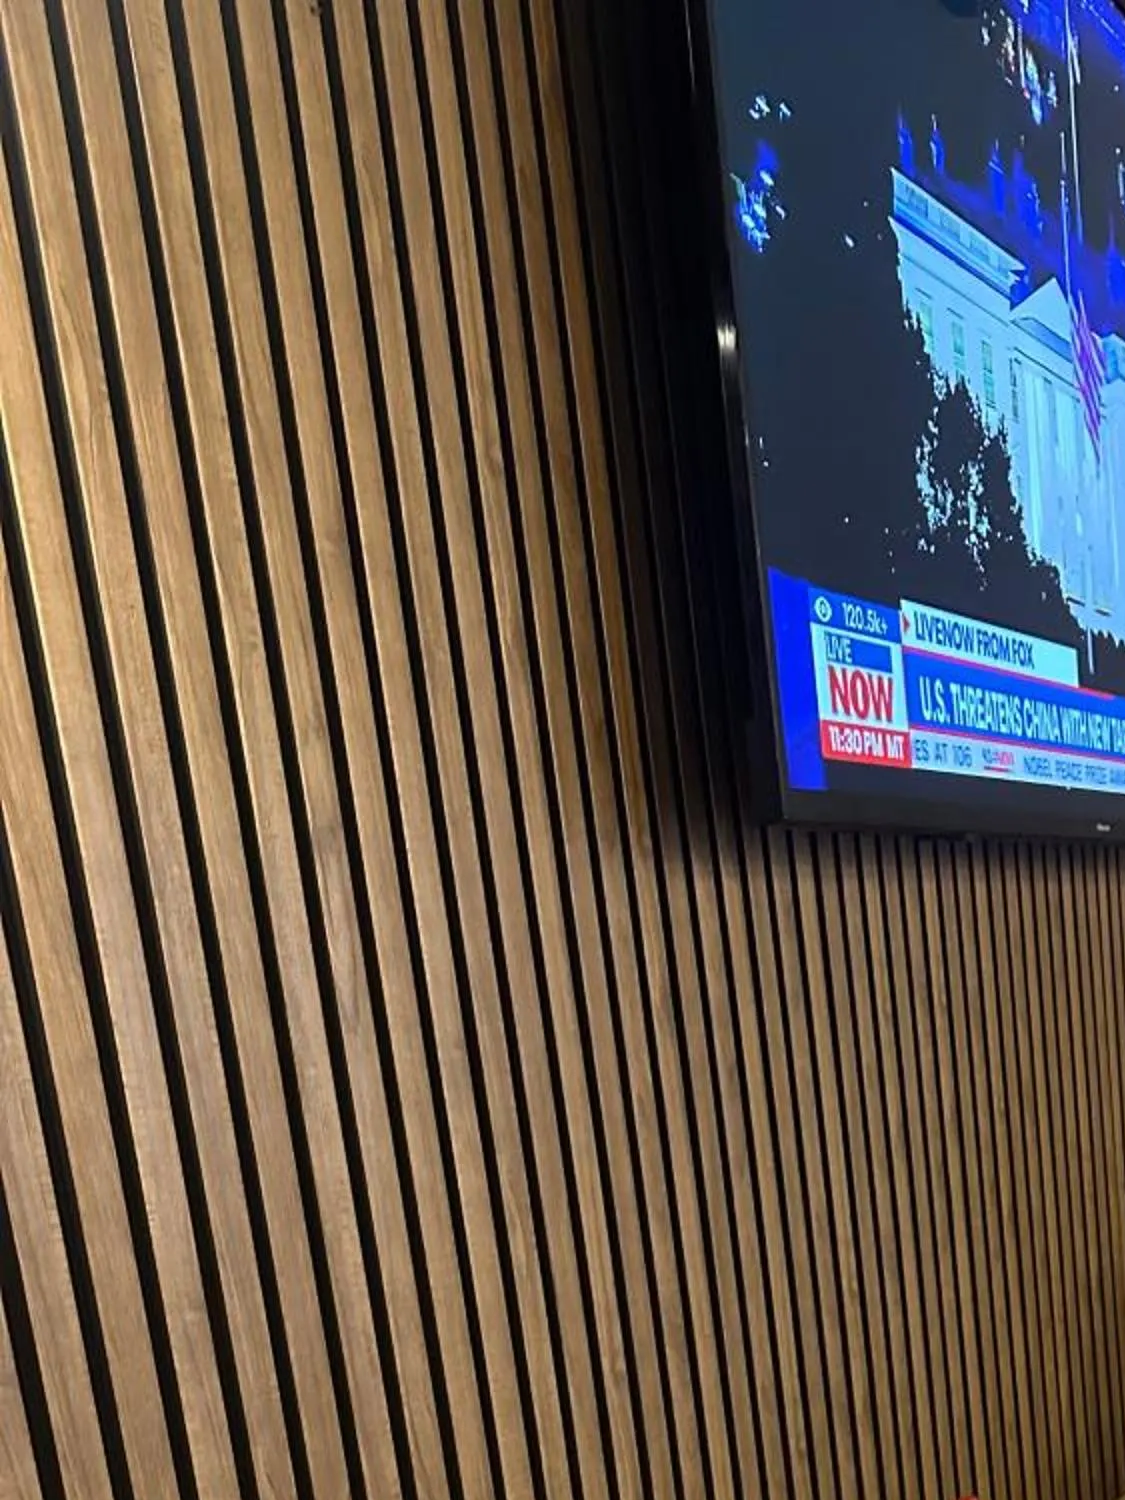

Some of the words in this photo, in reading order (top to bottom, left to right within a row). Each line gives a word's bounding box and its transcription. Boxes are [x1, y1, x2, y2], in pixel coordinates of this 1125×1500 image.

[824, 633, 853, 665] LIVE
[914, 611, 973, 653] LIVENOW
[976, 627, 1010, 663] FROM
[1011, 637, 1035, 670] FOX
[828, 664, 894, 724] NOW
[919, 675, 949, 725] U.S.
[950, 683, 1023, 737] THREATENS
[1023, 697, 1061, 743] CHINA
[1060, 705, 1088, 748] WITH
[1087, 711, 1112, 753] NEW
[829, 725, 862, 755] 11:30
[863, 730, 886, 758] PM
[886, 733, 905, 761] MT
[934, 742, 949, 765] AT
